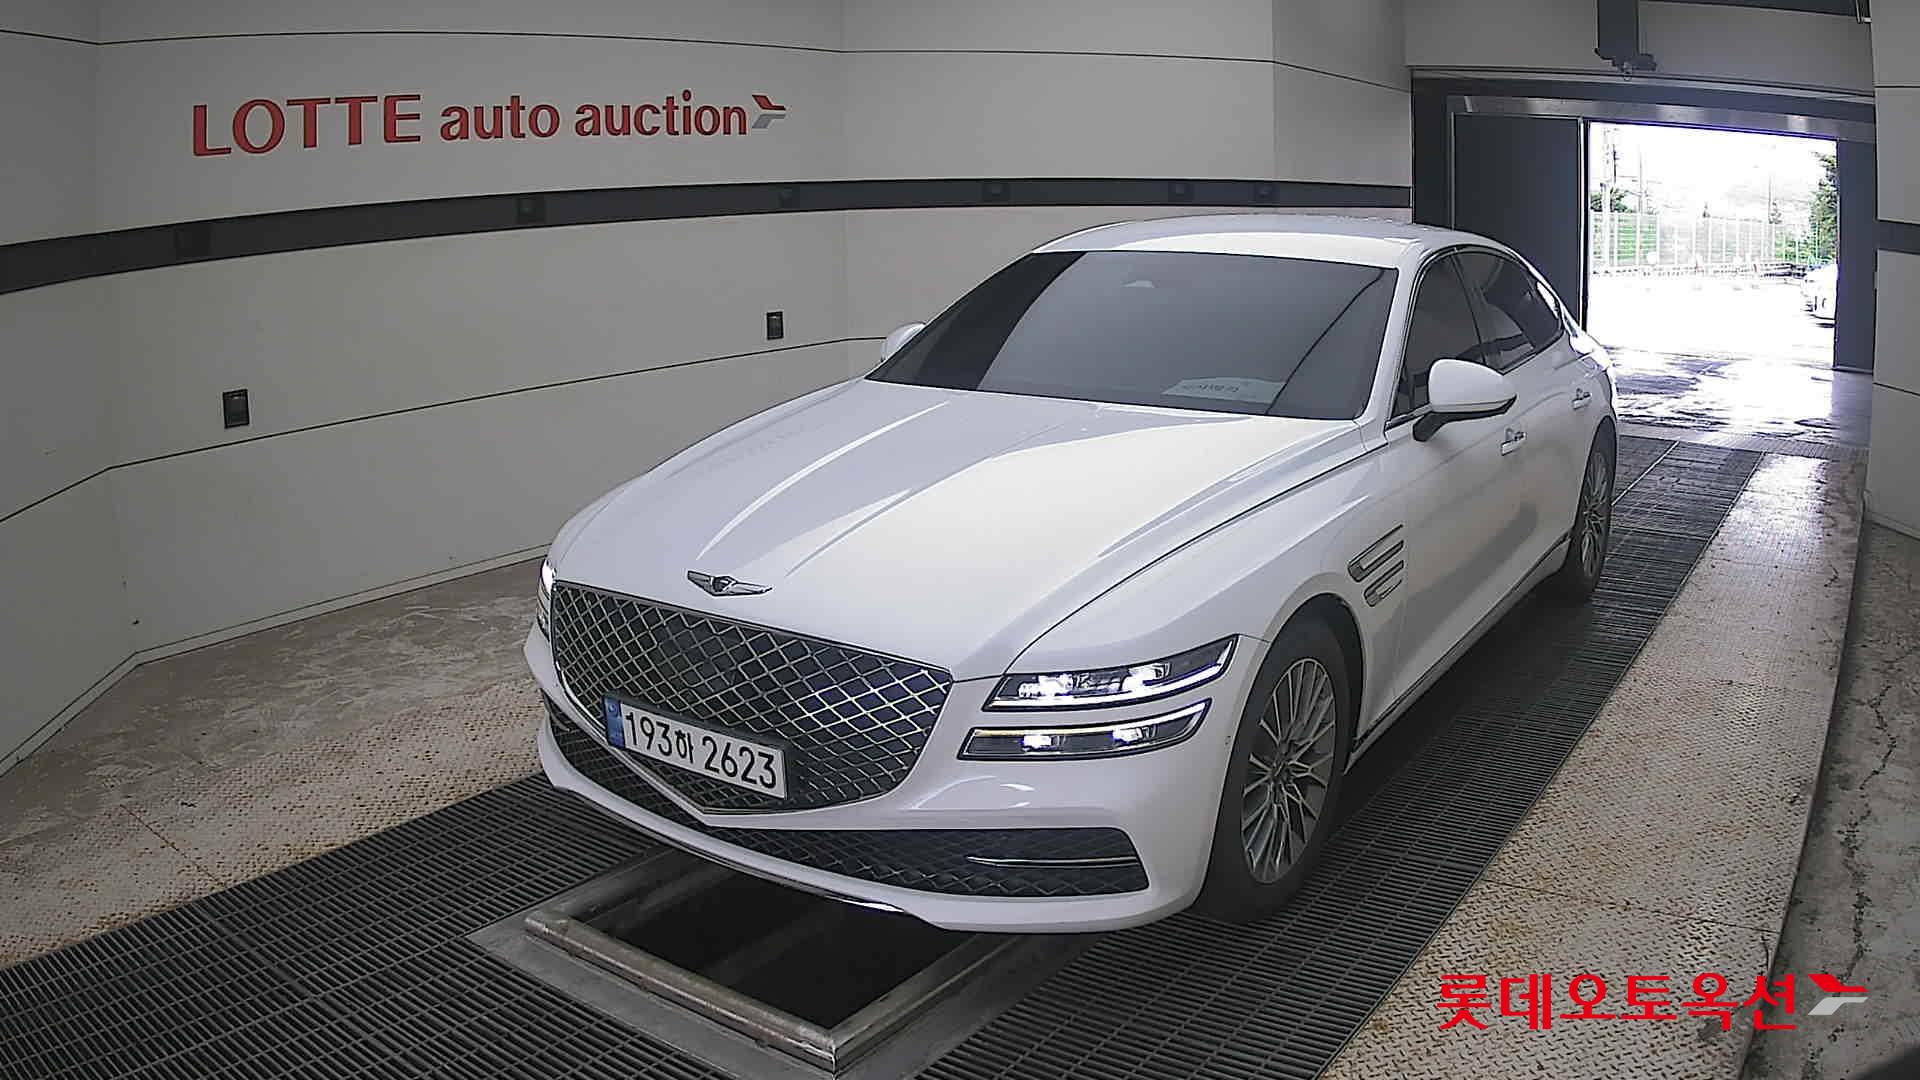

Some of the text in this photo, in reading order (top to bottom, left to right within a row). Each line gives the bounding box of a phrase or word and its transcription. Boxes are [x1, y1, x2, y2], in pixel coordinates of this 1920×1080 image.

[192, 89, 749, 157] LOTTE auto auction
[625, 711, 777, 789] 193하 2623
